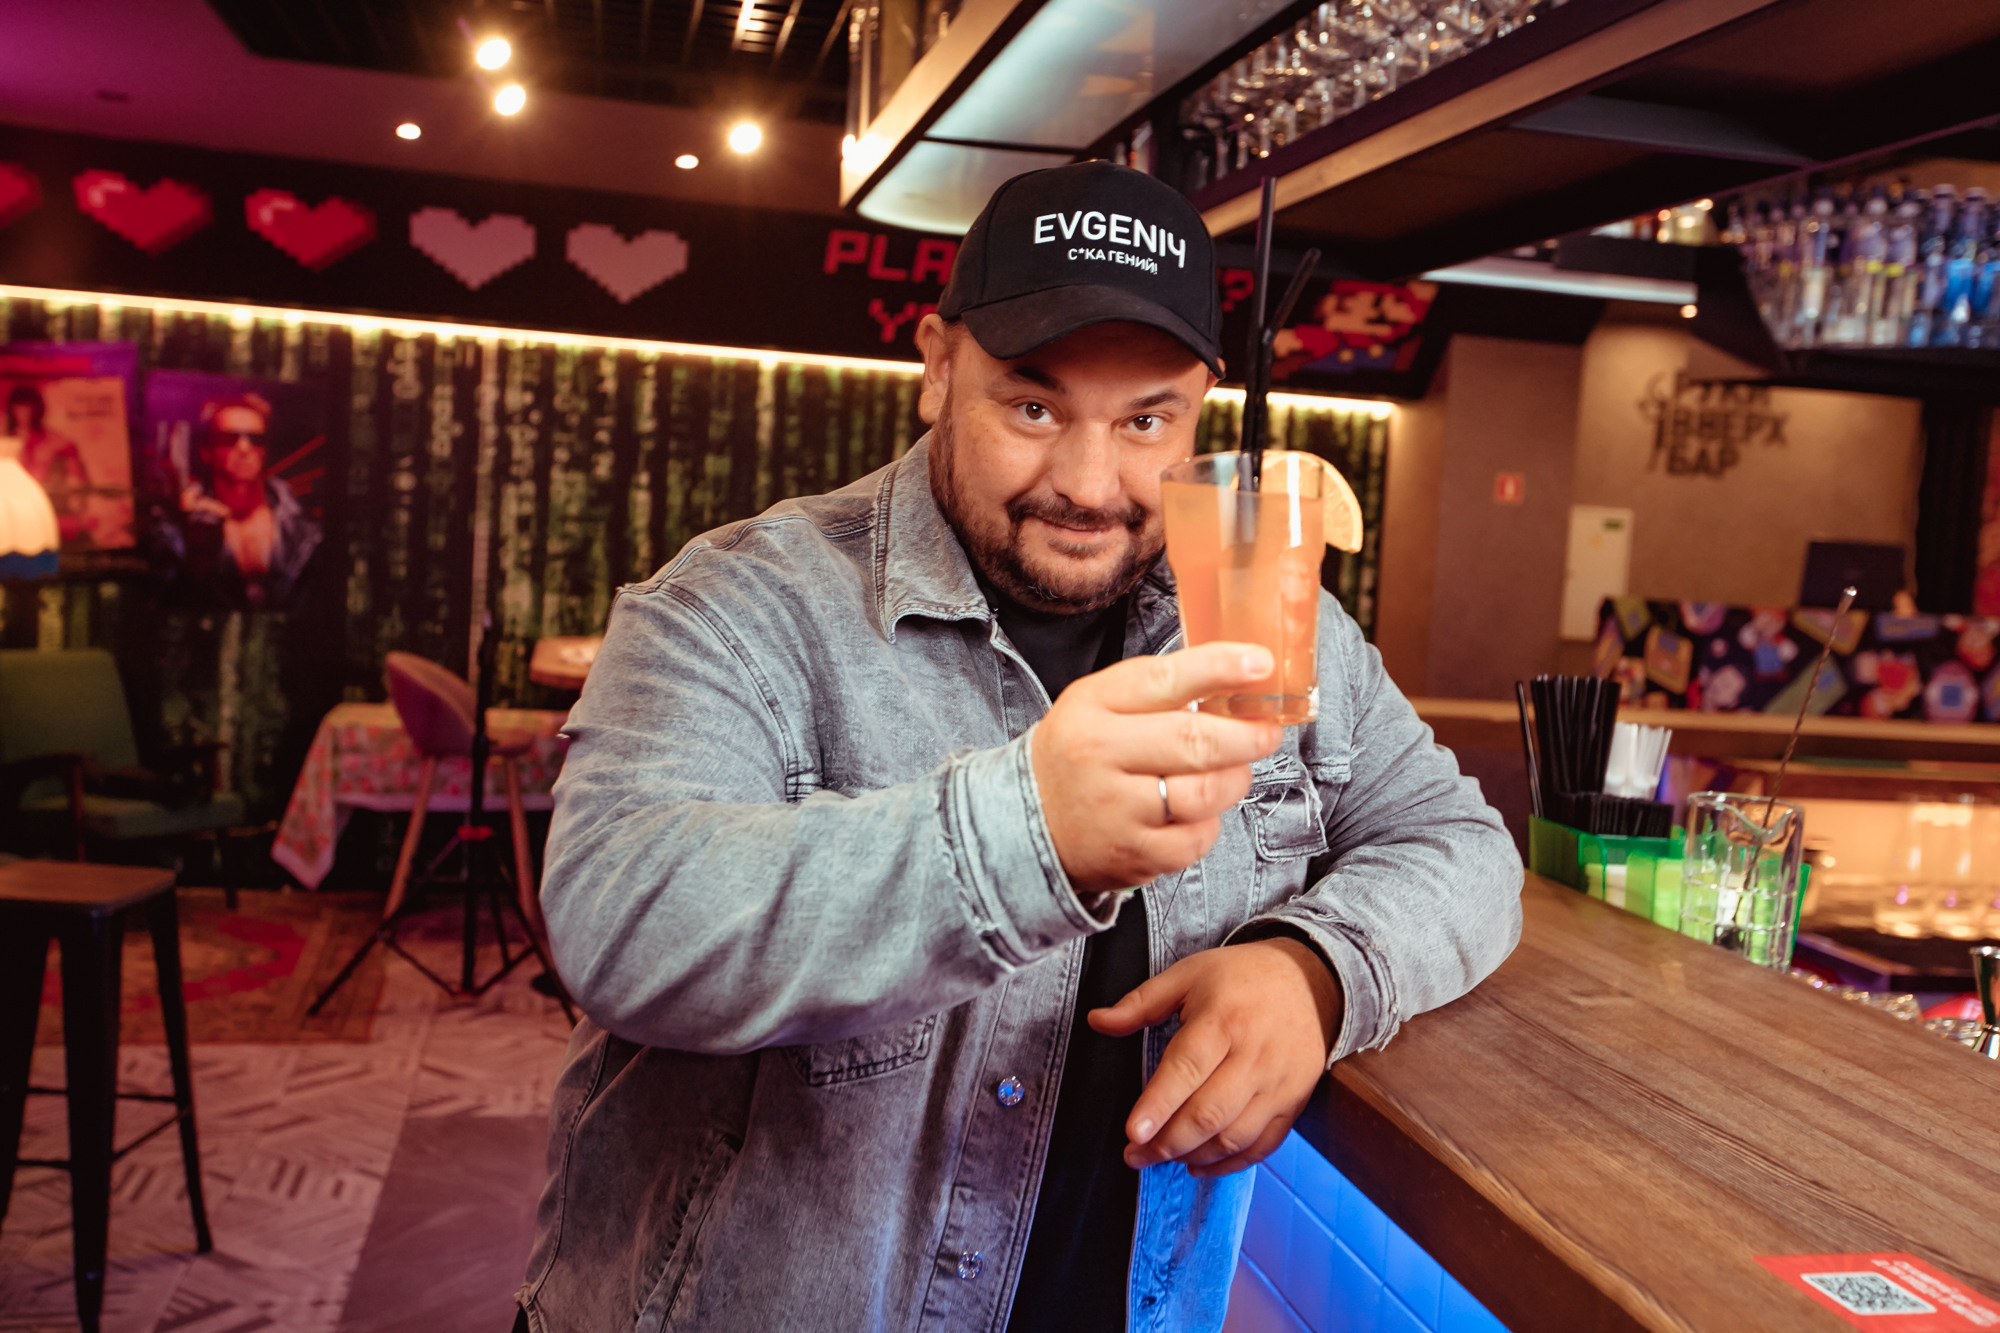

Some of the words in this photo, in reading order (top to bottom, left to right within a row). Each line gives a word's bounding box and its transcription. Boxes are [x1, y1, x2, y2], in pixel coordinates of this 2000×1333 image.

[823, 229, 959, 285] PLA
[1107, 250, 1158, 275] ГЕНИЙ!
[1665, 441, 1741, 479] БАР
